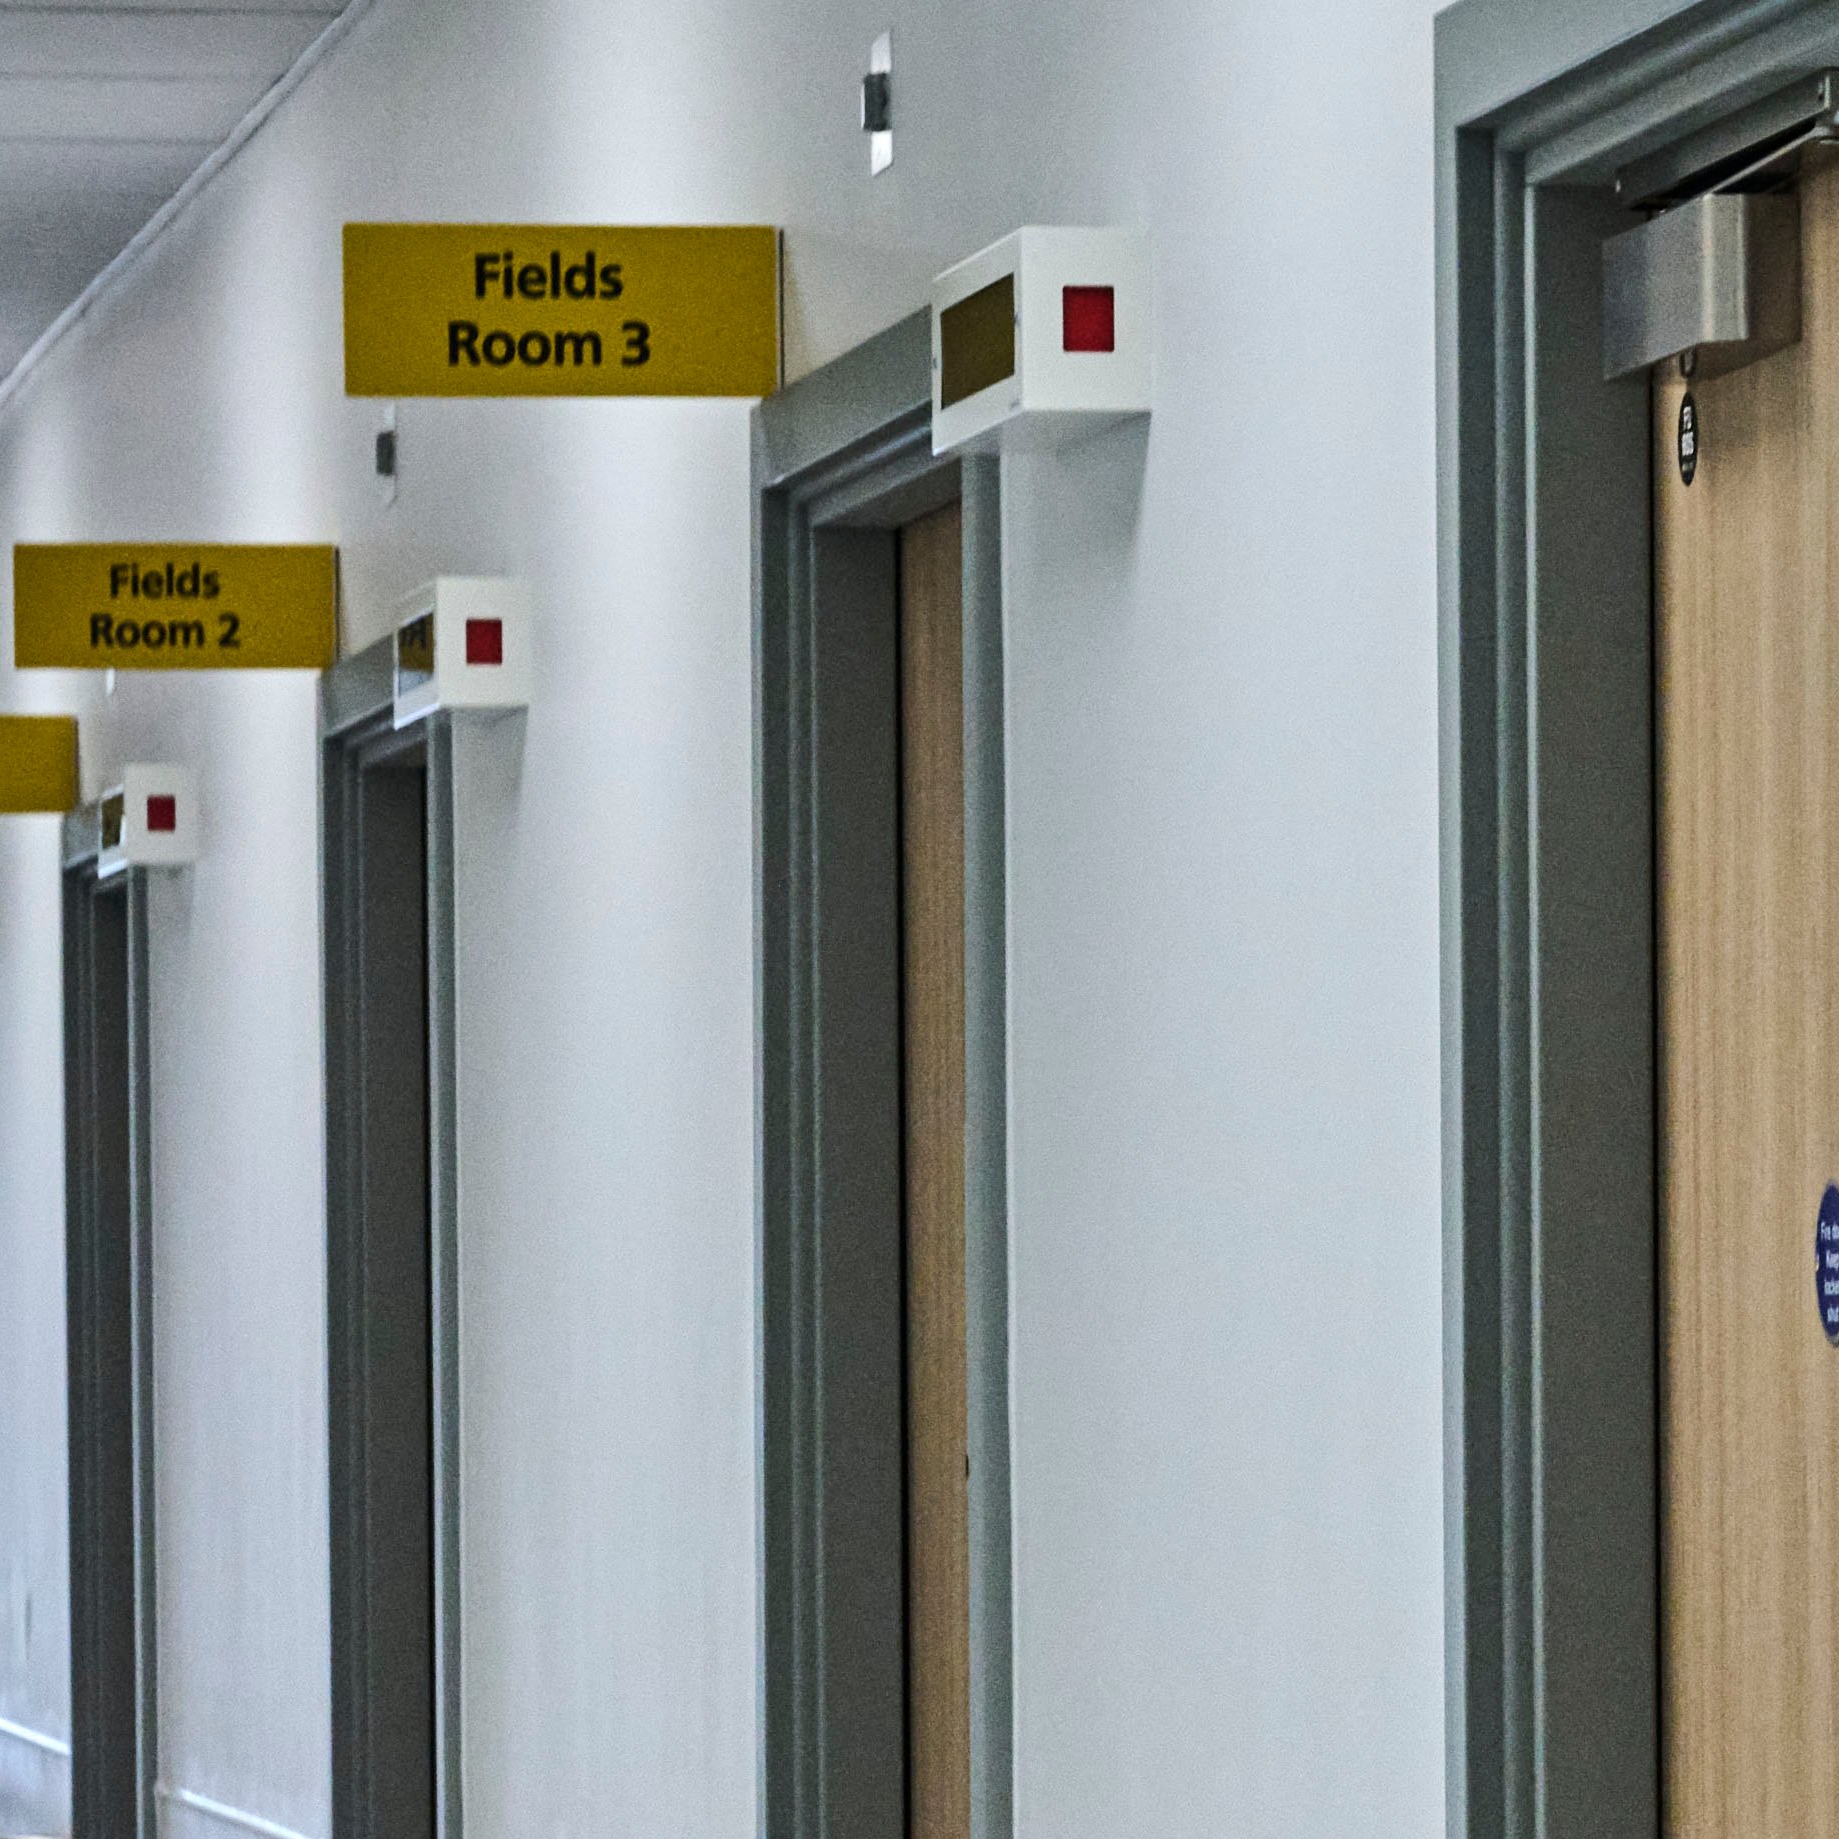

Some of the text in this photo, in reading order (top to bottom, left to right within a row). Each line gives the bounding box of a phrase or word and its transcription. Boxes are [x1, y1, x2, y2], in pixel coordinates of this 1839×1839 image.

[474, 251, 624, 299] Fields
[448, 321, 651, 366] Room 3
[109, 562, 221, 599] Fields
[90, 613, 241, 648] Room 2
